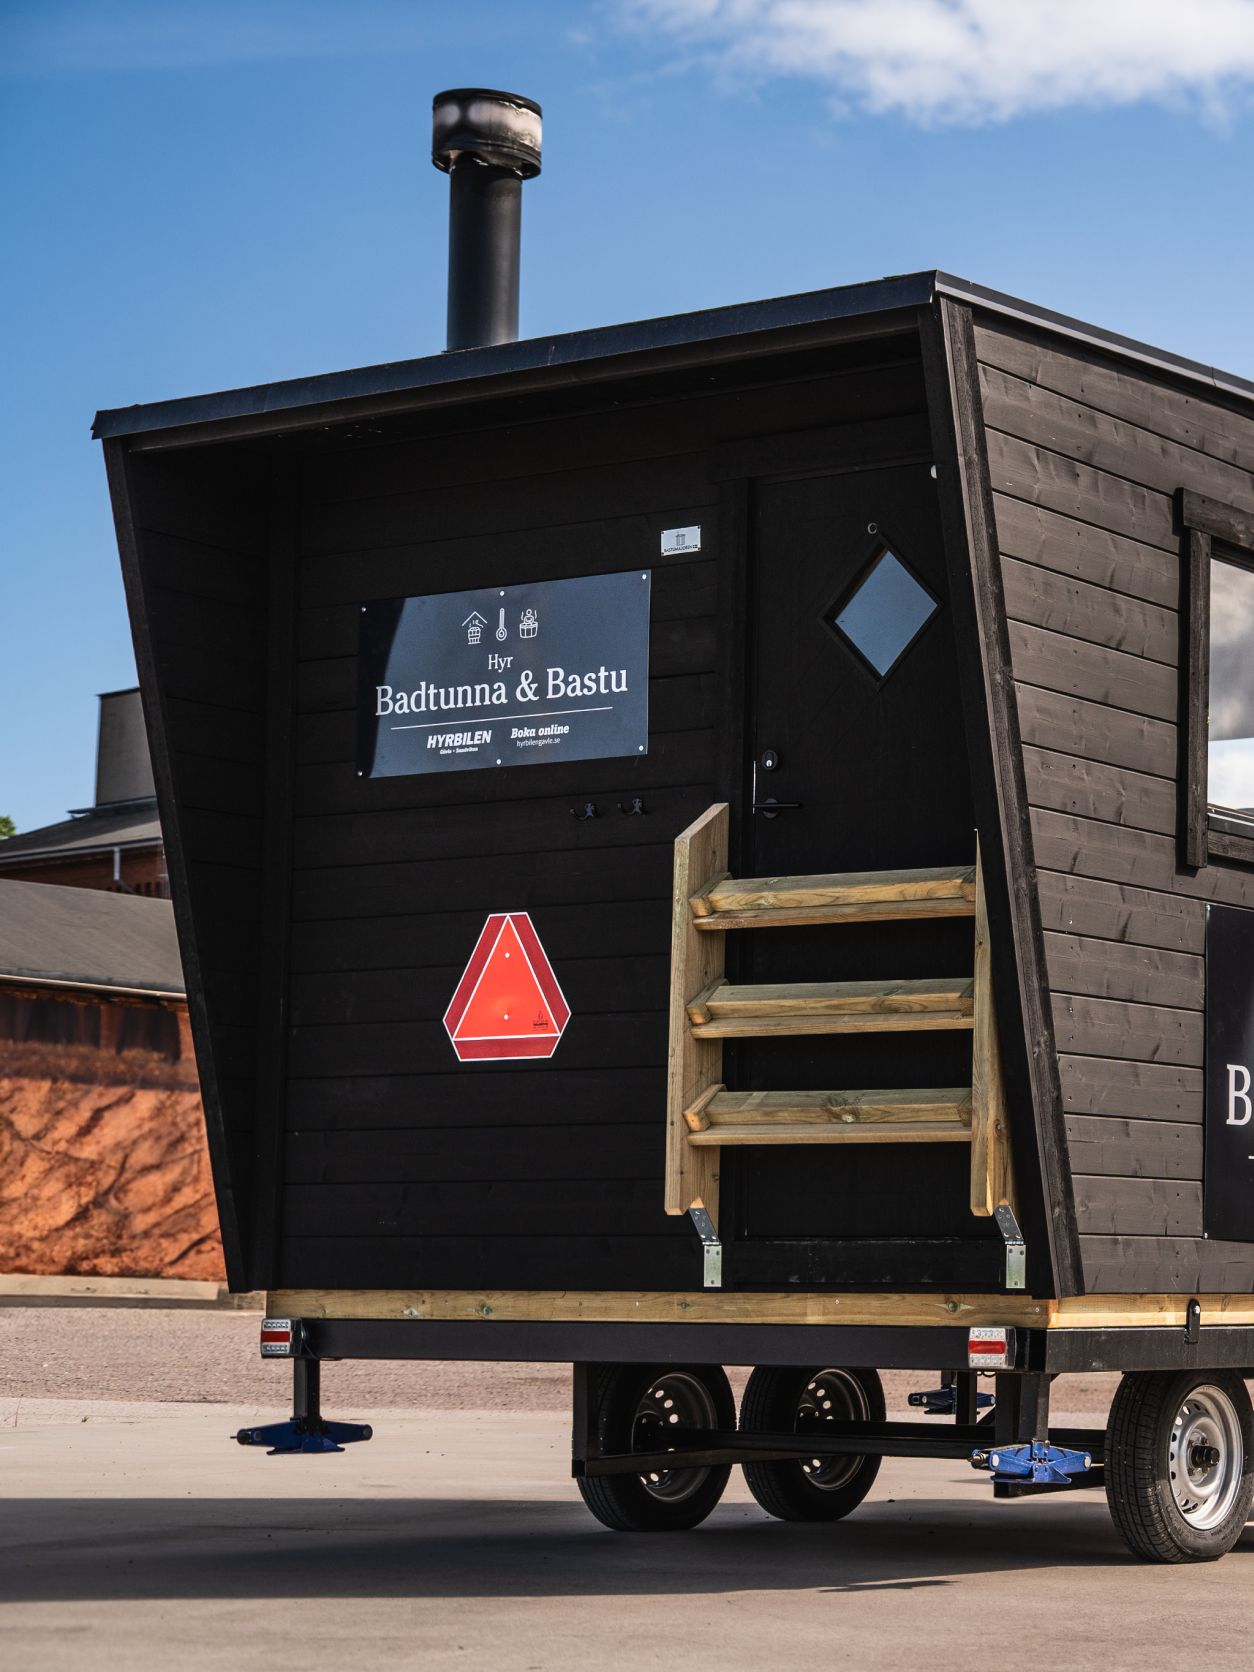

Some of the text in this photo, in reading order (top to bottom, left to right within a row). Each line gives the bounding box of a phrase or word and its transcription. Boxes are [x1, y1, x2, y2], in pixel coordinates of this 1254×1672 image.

[487, 653, 513, 672] Hyr
[375, 665, 628, 716] Badtunna & Bastu
[427, 730, 492, 749] HYRBILEN
[510, 724, 570, 739] Boka online
